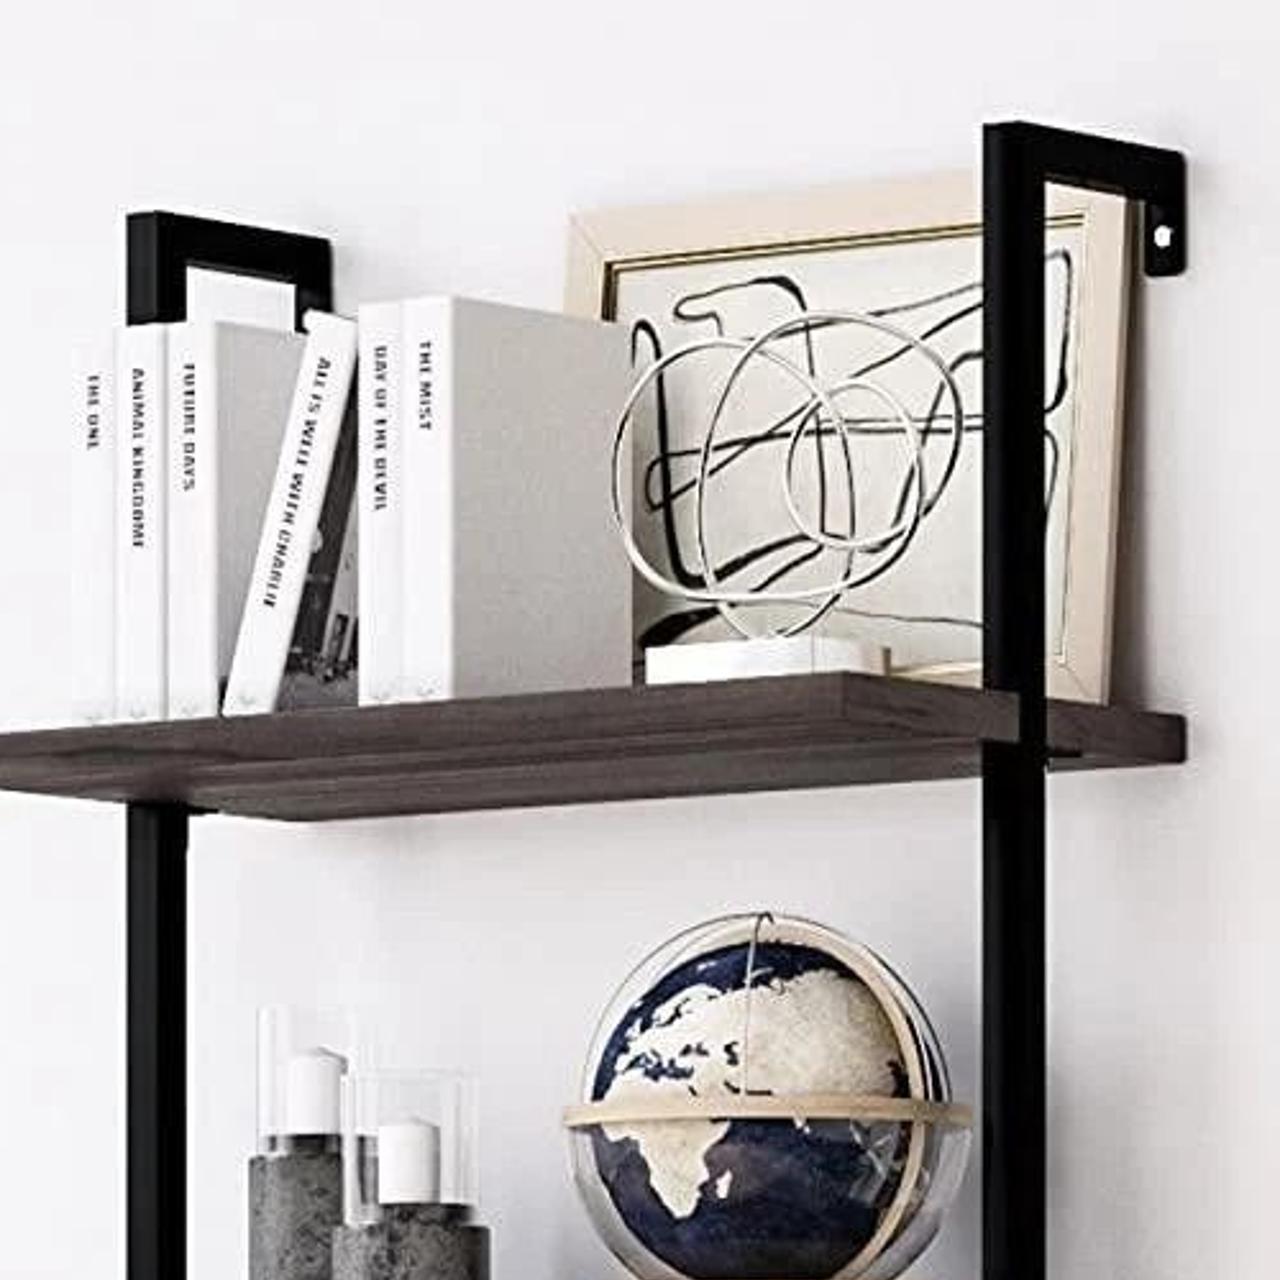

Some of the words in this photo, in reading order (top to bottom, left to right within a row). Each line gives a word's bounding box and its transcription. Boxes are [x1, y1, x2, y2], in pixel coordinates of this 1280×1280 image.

[373, 345, 388, 383] DAY
[418, 340, 432, 374] THE
[132, 367, 146, 439] ANIMAL
[183, 363, 196, 436] FUTURE
[308, 393, 323, 413] IS
[418, 379, 432, 431] MIST
[183, 441, 196, 492] DAYS
